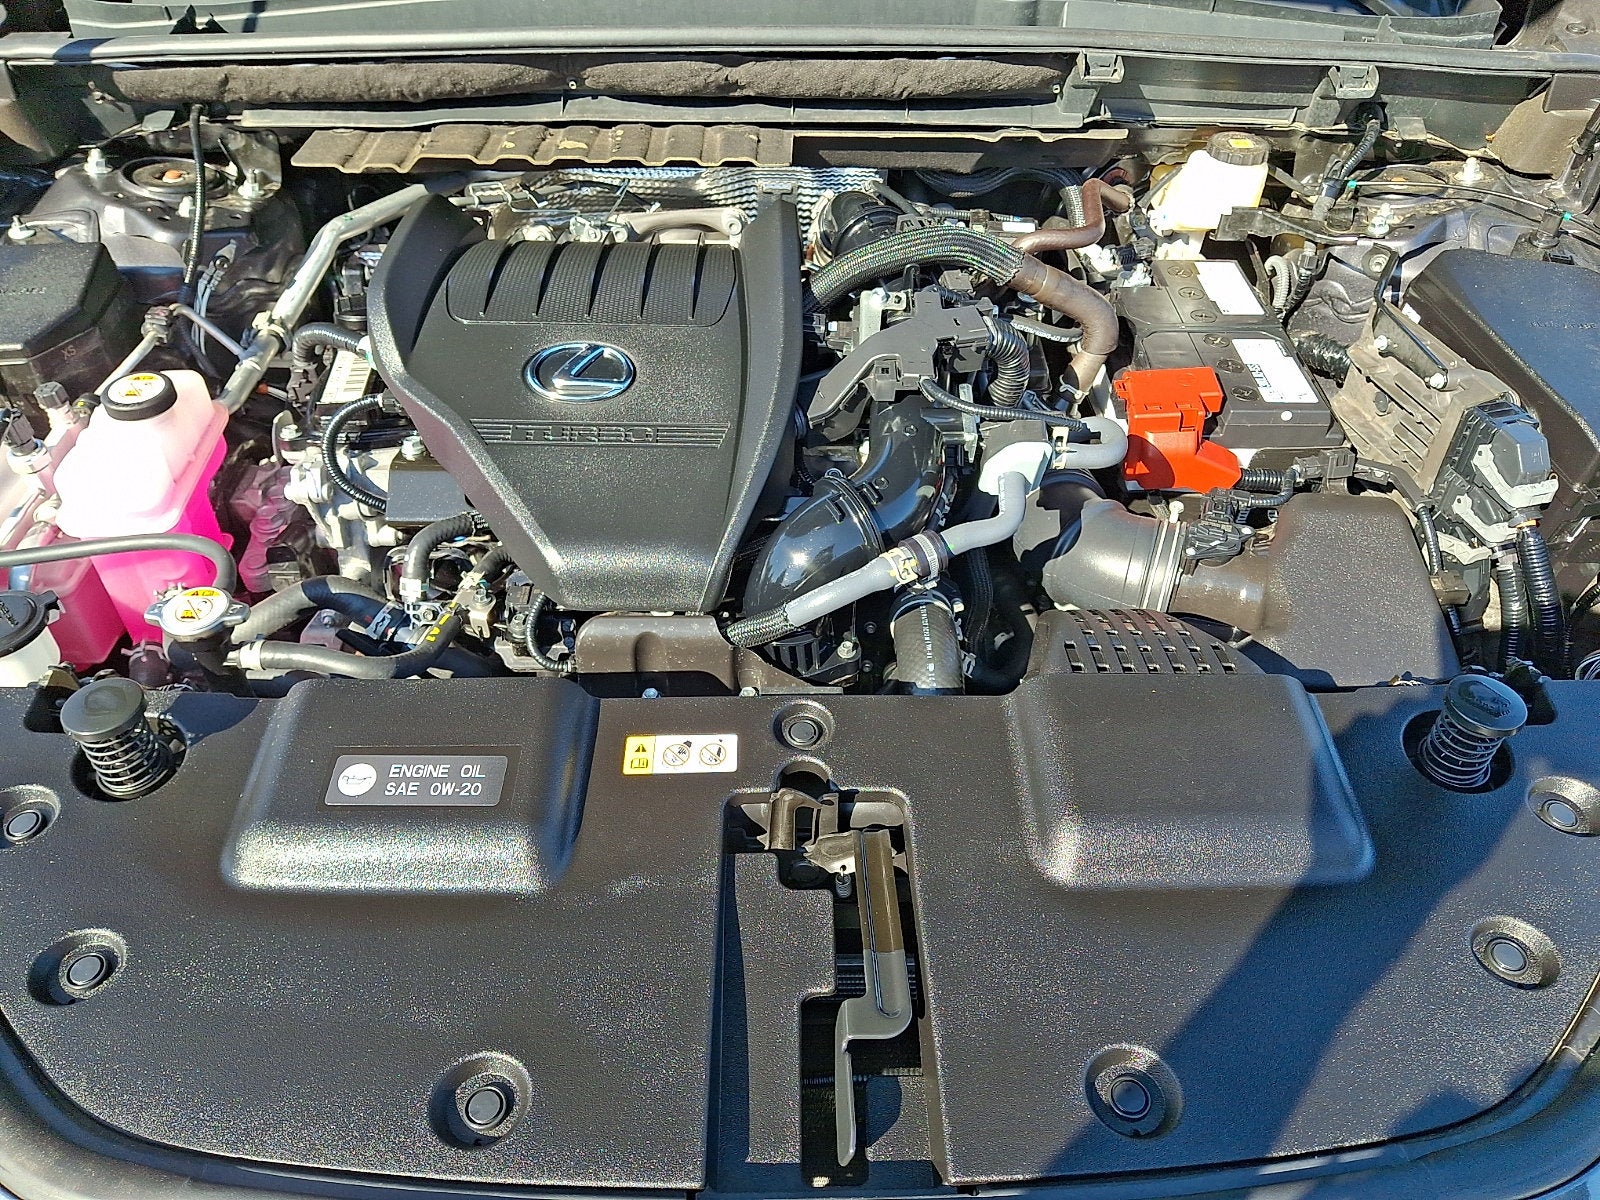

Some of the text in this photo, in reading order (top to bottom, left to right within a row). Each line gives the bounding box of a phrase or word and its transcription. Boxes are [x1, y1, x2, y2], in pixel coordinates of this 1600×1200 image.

[512, 423, 655, 444] TURBO
[388, 764, 487, 779] ENGINE OIL
[384, 782, 483, 796] SAE 0W-20
